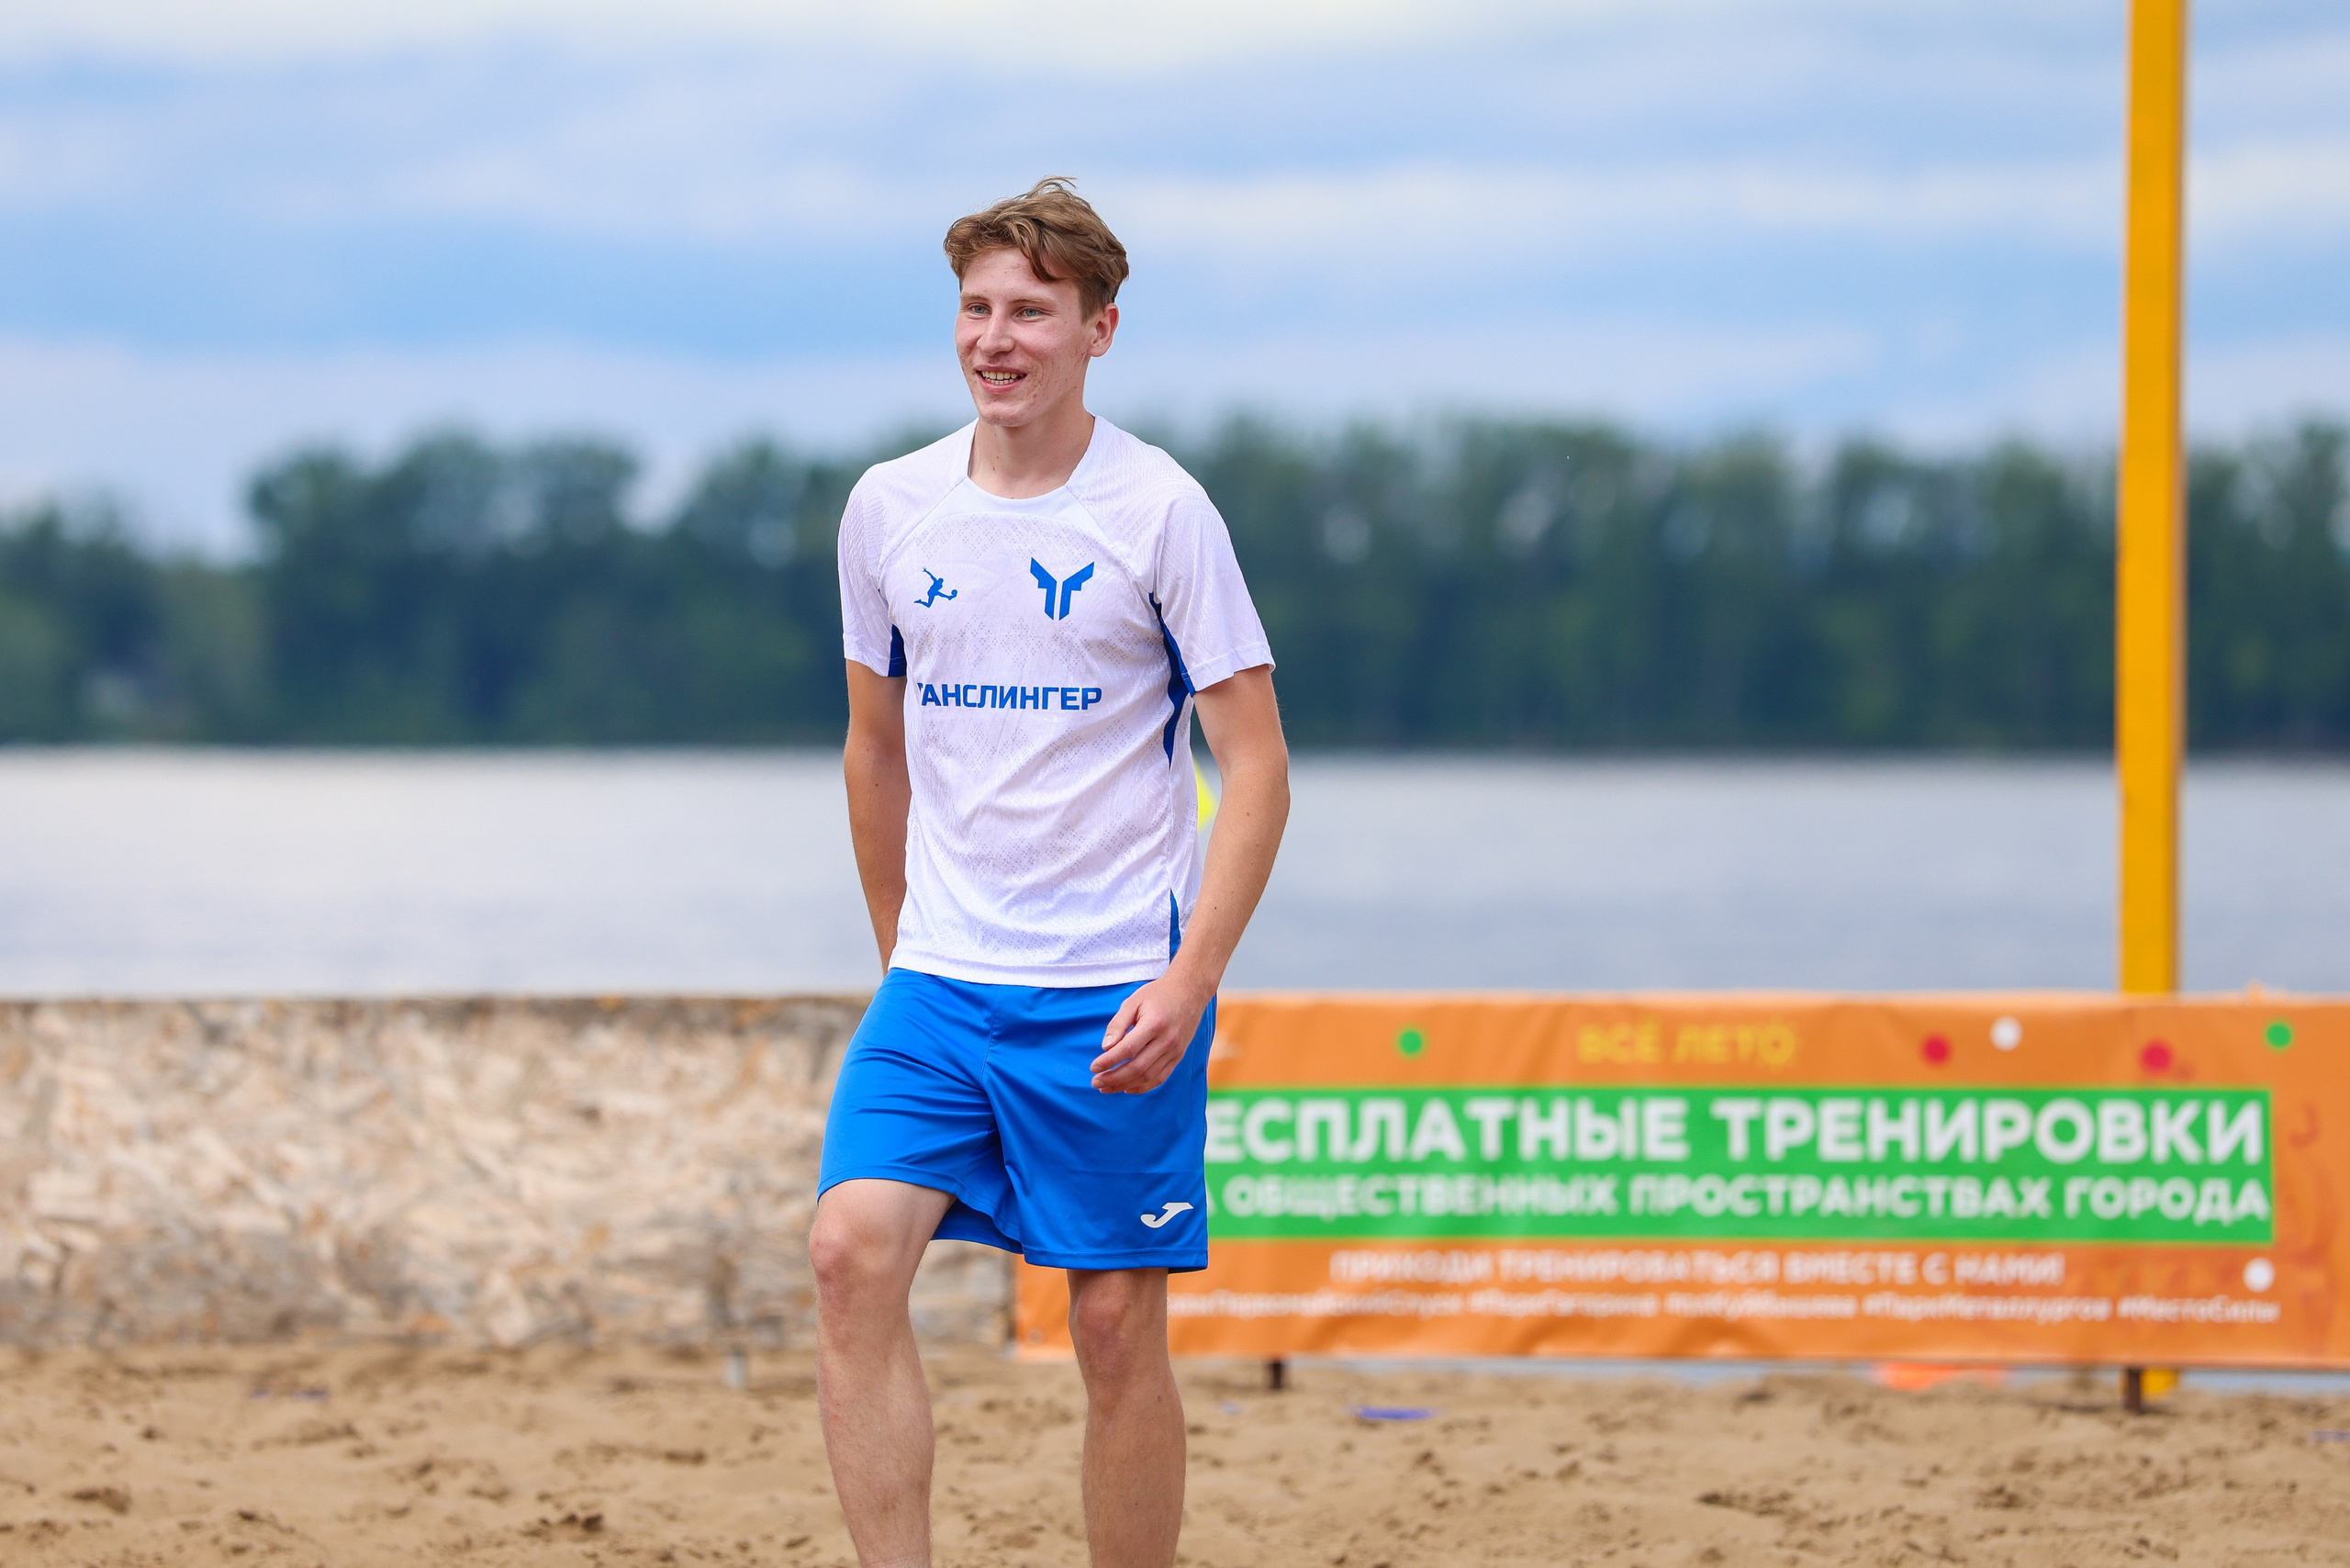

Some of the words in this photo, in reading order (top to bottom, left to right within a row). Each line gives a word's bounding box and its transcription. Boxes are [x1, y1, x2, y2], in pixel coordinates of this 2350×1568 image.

[917, 682, 1102, 711] АНСЛИНГЕР
[1204, 1097, 1691, 1163] ЕСПЛАТНЫЕ
[1711, 1097, 2263, 1165] ТРЕНИРОВКИ
[1222, 1174, 1619, 1222] ОБЩЕСТВЕННЫХ
[1628, 1174, 2053, 1219] ПРОСТРАНСТВАХ
[2063, 1176, 2271, 1226] ГОРОДА
[1330, 1250, 1493, 1284] ПРИХОДИ
[1499, 1249, 1779, 1283] ТРЕНИРОВАТЬСЯ
[1784, 1251, 1919, 1285] ВМЕСТЕ
[1922, 1252, 1951, 1285] С
